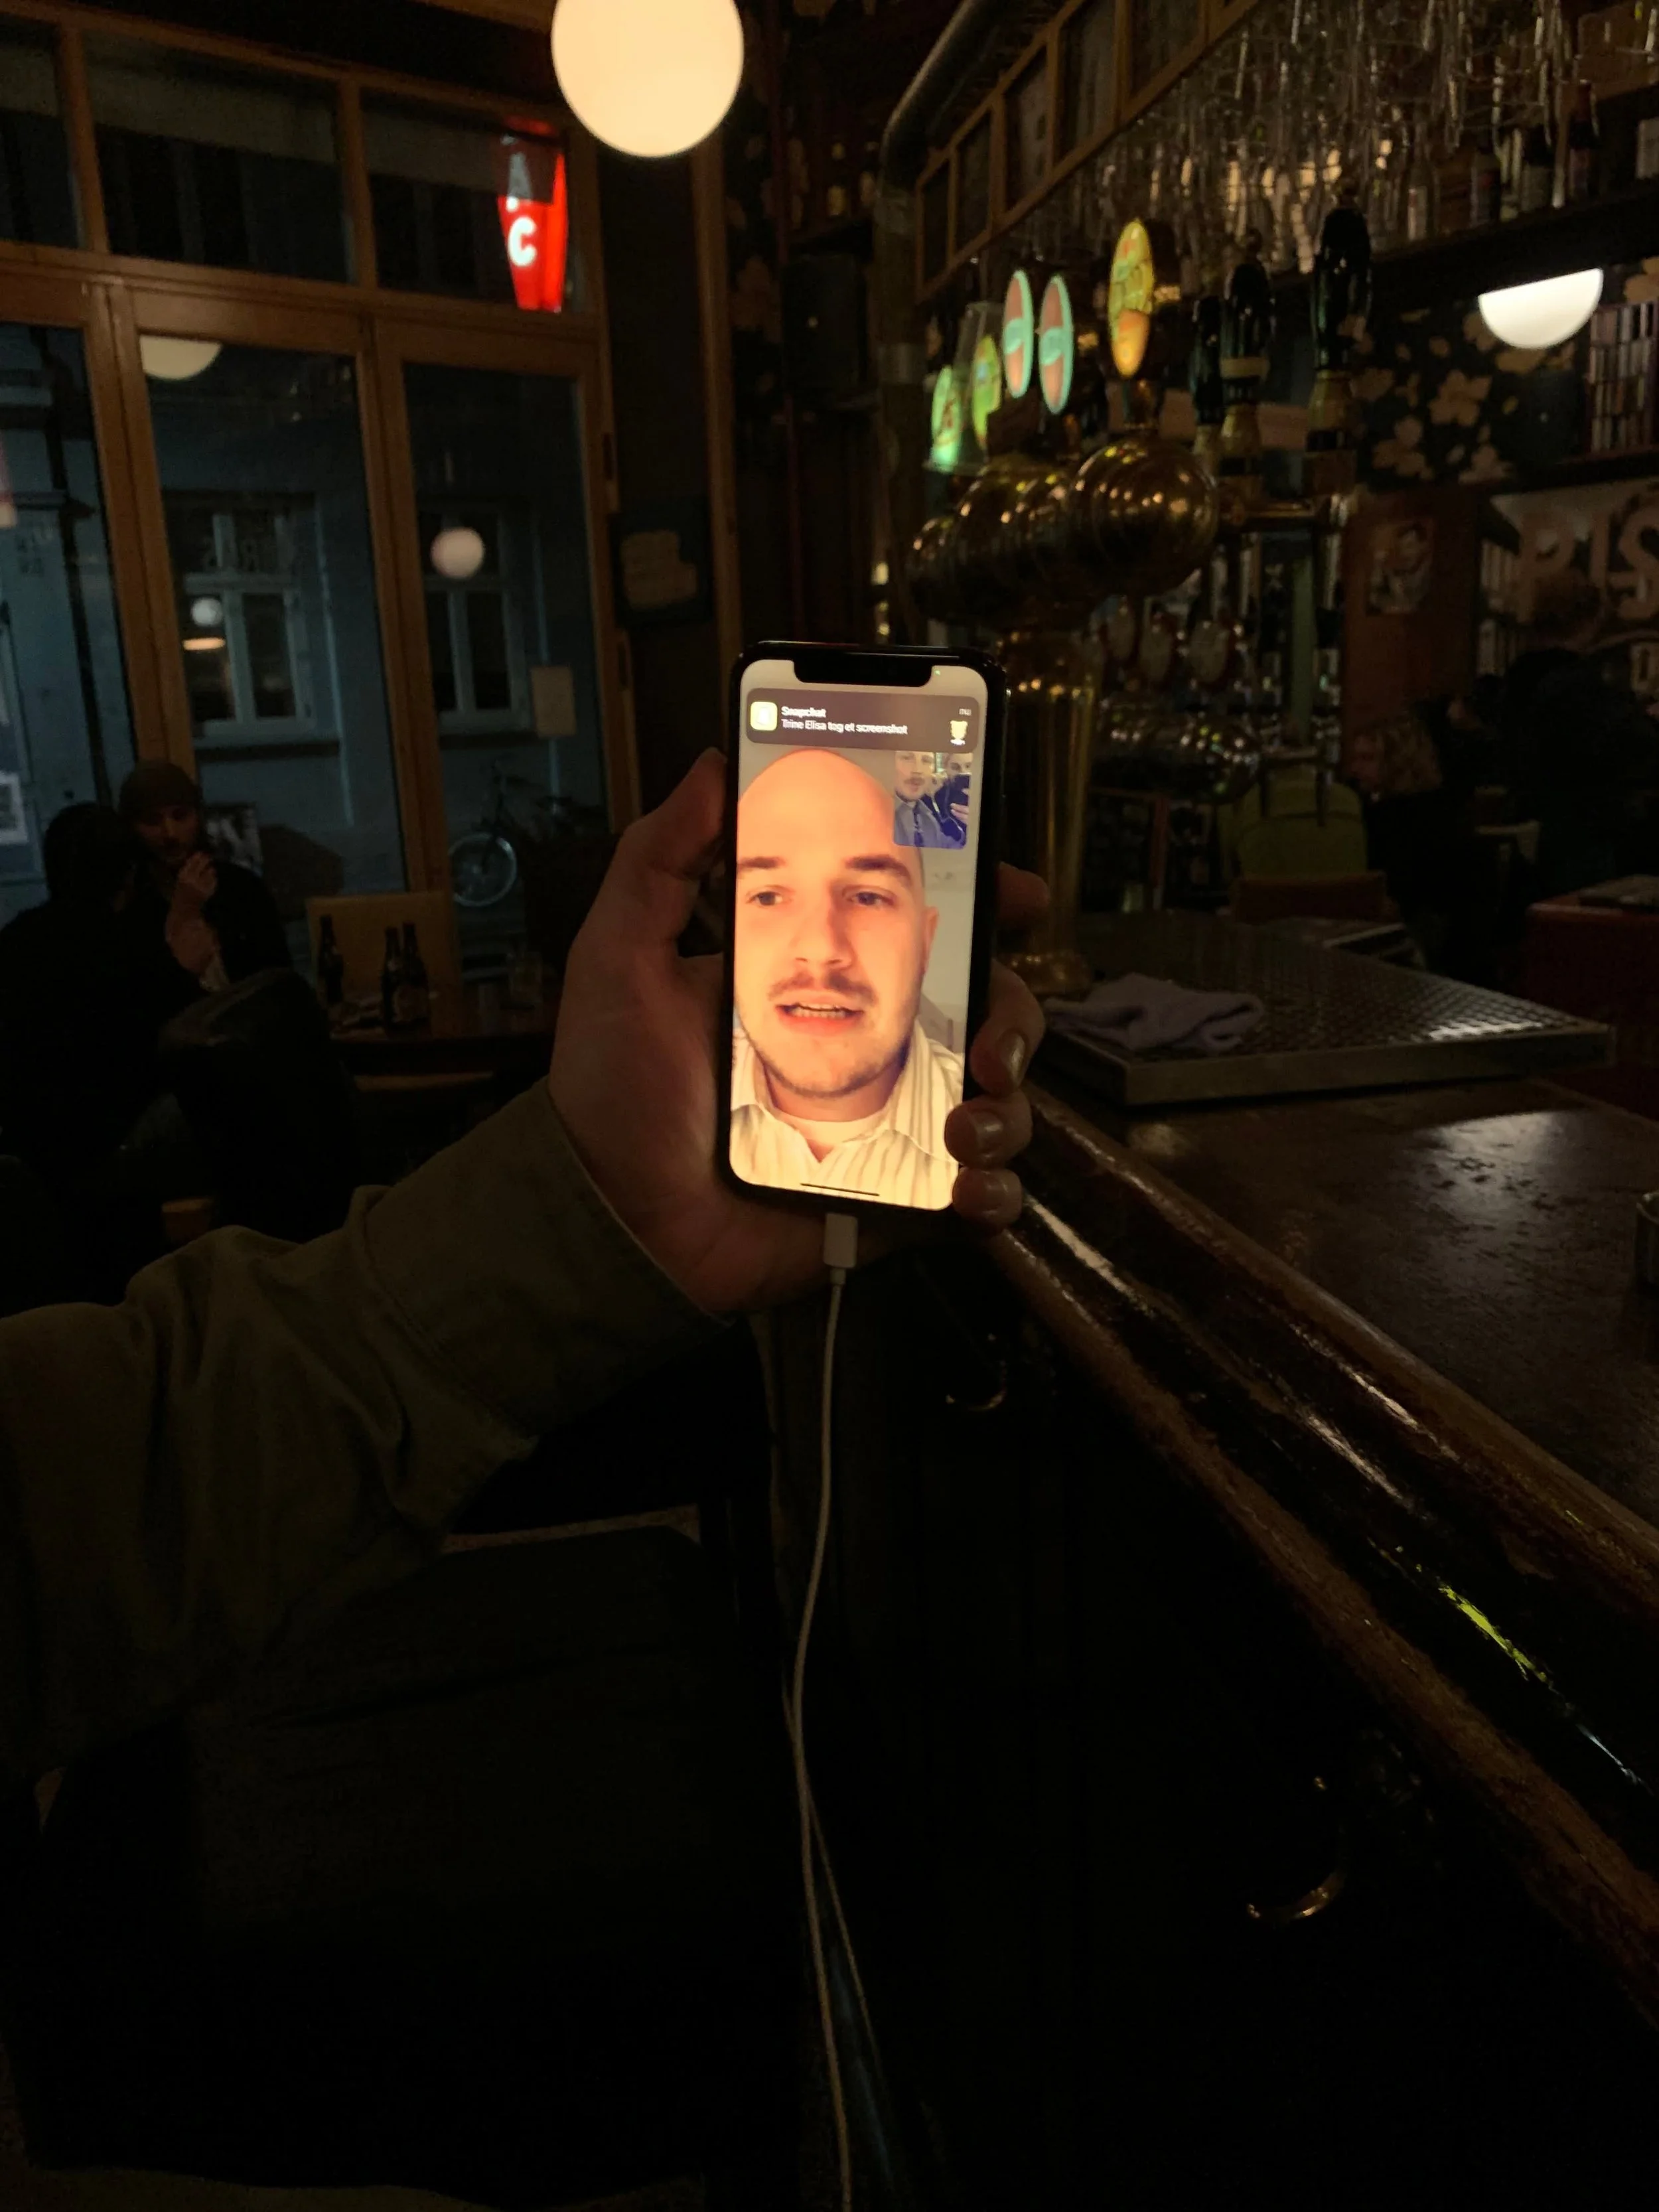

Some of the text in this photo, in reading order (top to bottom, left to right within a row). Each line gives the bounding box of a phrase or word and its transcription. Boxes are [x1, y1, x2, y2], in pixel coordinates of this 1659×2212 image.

[781, 706, 827, 718] Snapchat
[781, 719, 908, 735] Trine Elisa tog et screenshot
